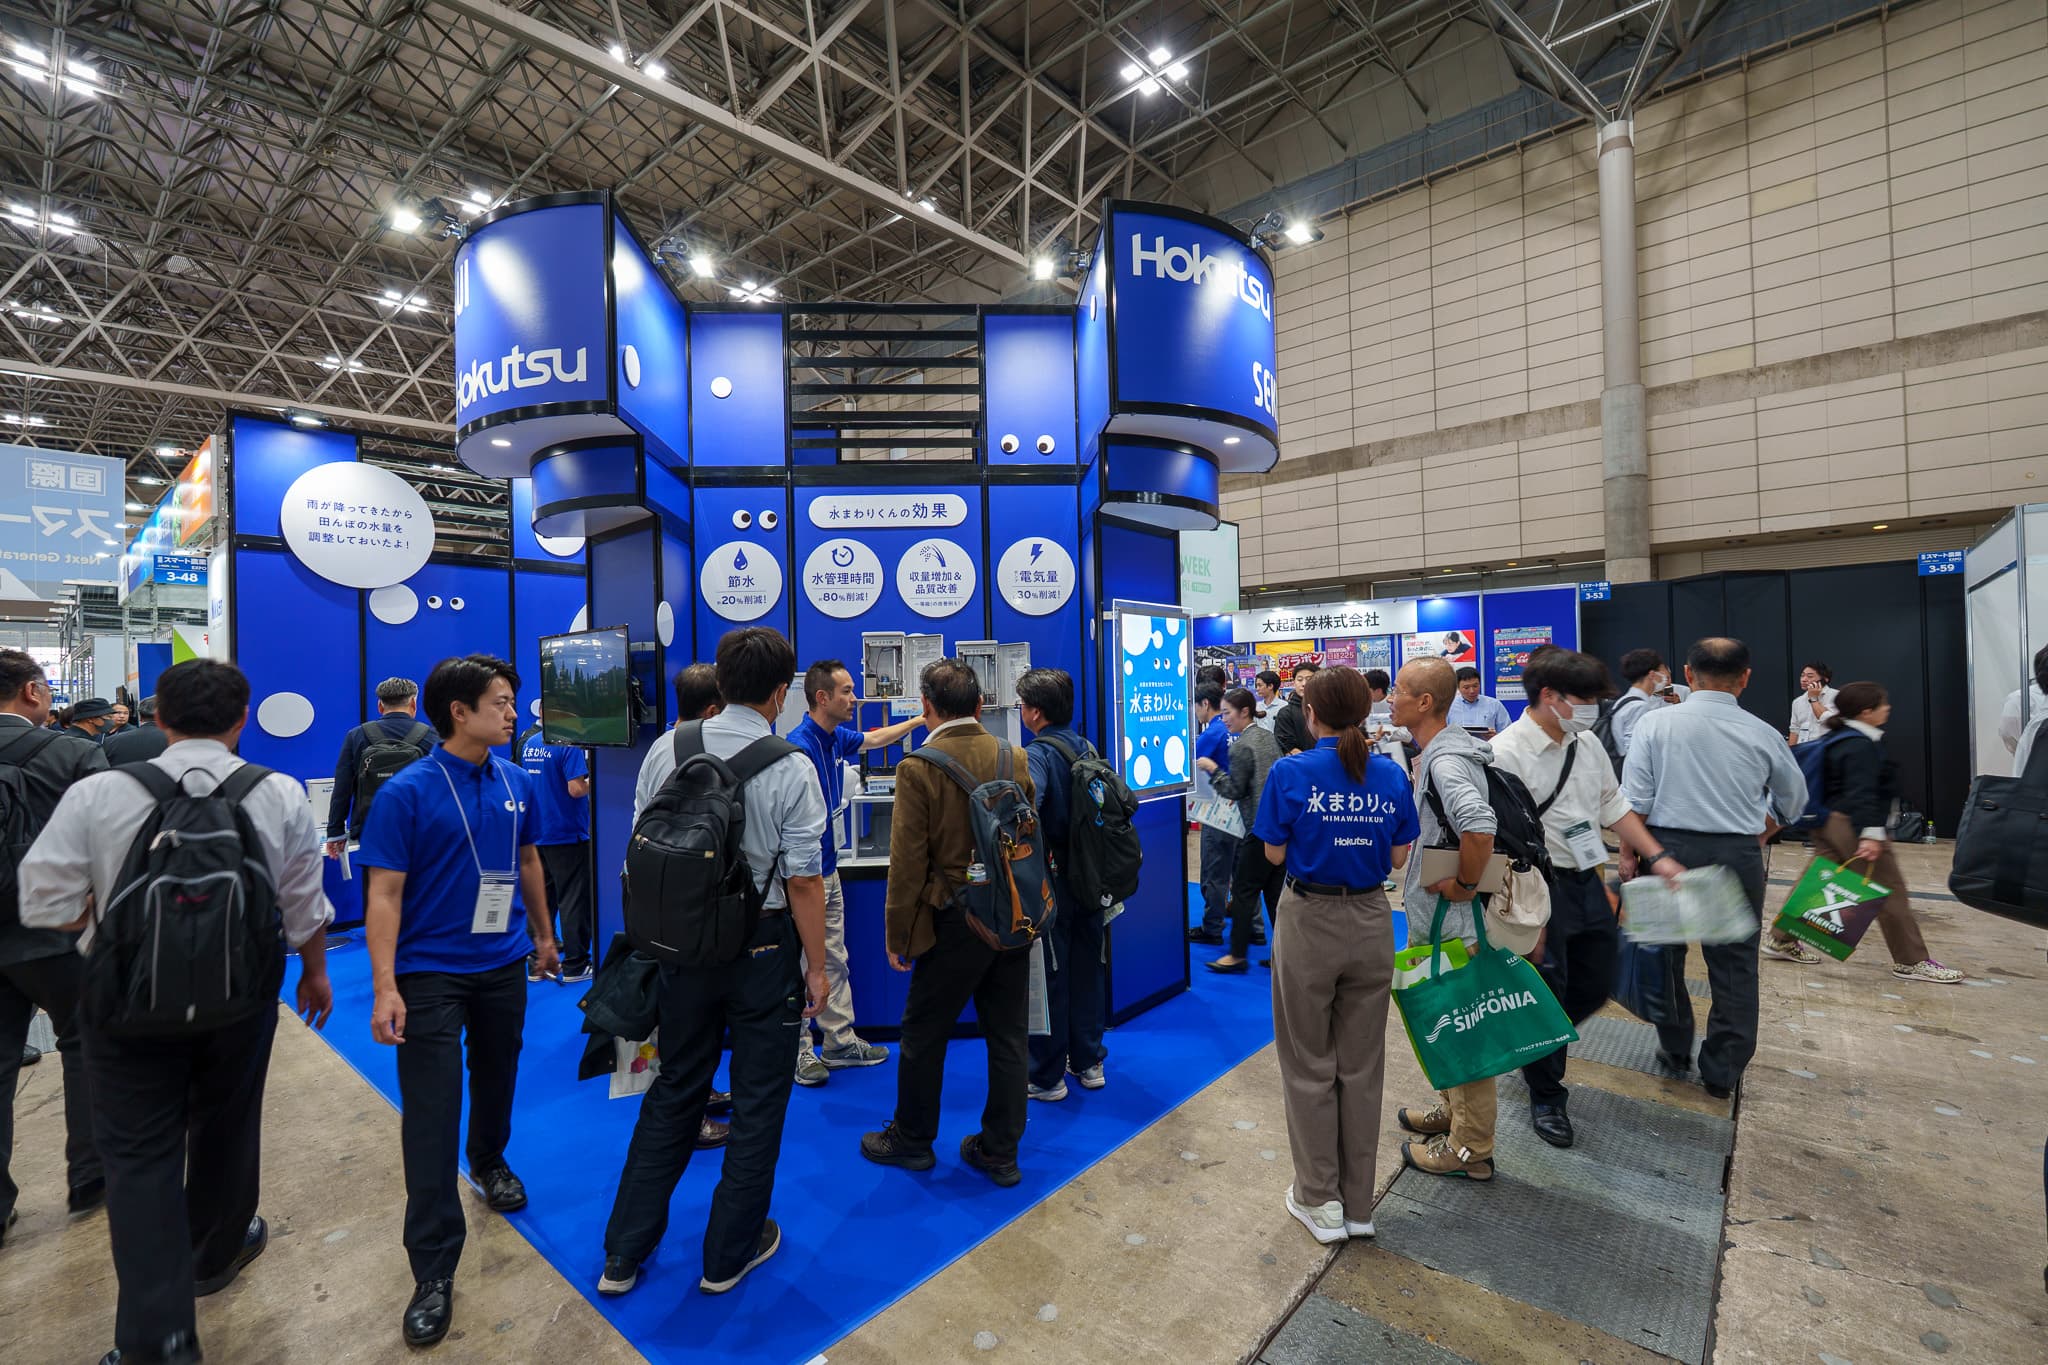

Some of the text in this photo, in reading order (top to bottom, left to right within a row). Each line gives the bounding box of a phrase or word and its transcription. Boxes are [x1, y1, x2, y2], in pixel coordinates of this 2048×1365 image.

[306, 499, 413, 519] 雨が降ってきたから
[829, 502, 948, 520] 水まわりくんの効果
[319, 516, 403, 534] 田んぼの水量を
[1929, 564, 1955, 573] 3-59
[166, 571, 199, 582] 3-48
[728, 575, 755, 588] 節水
[812, 572, 875, 585] 水管理時間
[1019, 570, 1059, 583] 電気量
[915, 584, 958, 595] 品質改善
[1262, 611, 1380, 634] 大起証券株式会社
[1129, 686, 1184, 713] 水まわりくん
[1307, 785, 1396, 814] 水まわりくん
[1323, 815, 1384, 823] MIMAWARIKUN
[1334, 837, 1373, 846] Hokutsu
[1455, 990, 1538, 1033] SINFONIA
